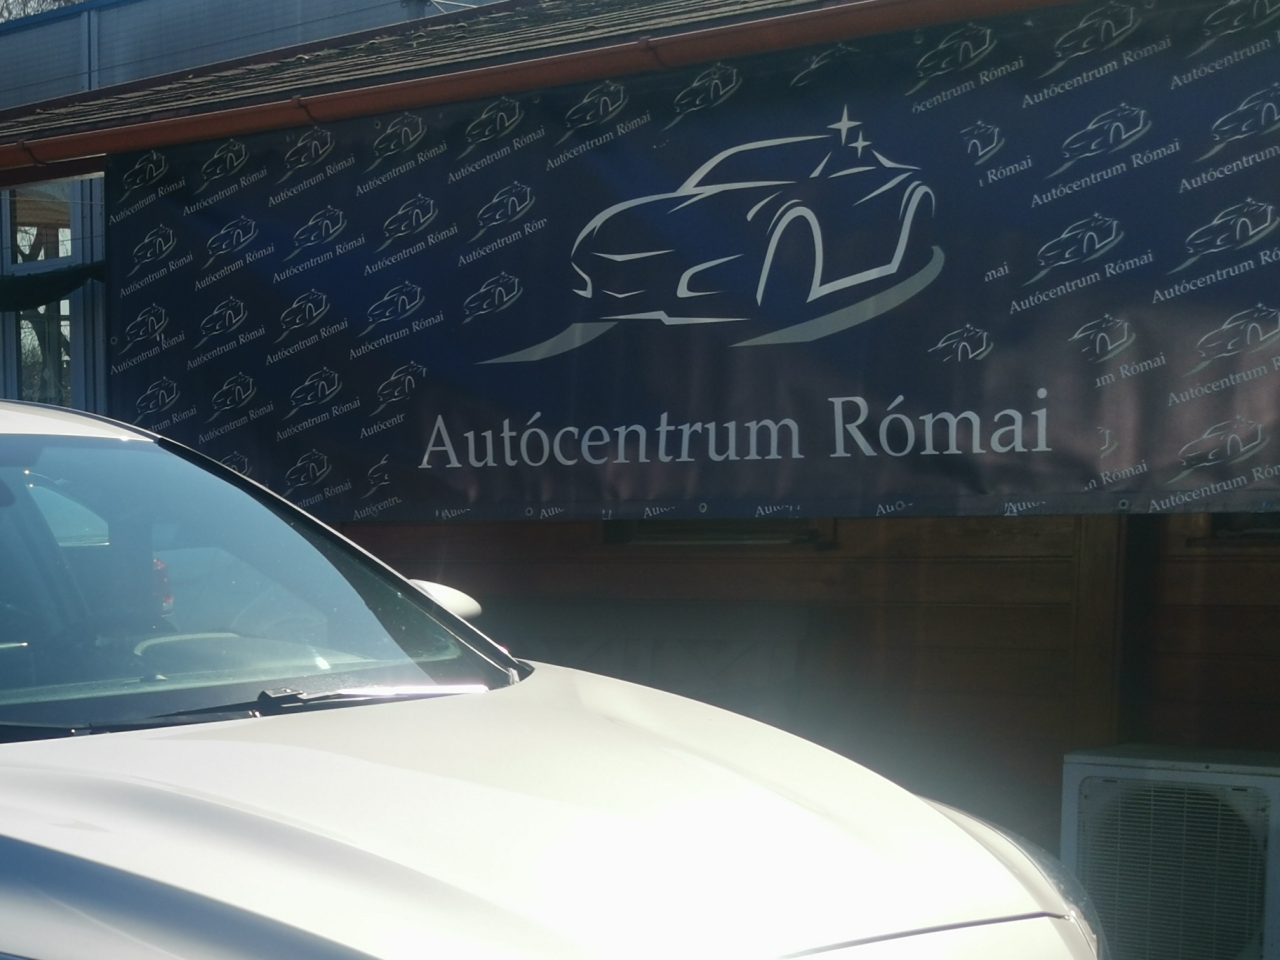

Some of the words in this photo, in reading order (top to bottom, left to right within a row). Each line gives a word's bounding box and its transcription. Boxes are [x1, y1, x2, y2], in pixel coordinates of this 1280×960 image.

[986, 155, 1033, 185] Római
[1009, 270, 1101, 315] Autócentrum
[1105, 249, 1154, 279] Római
[1152, 259, 1255, 304] Autócentrum
[417, 411, 806, 470] Autócentrum
[828, 387, 1053, 457] Római
